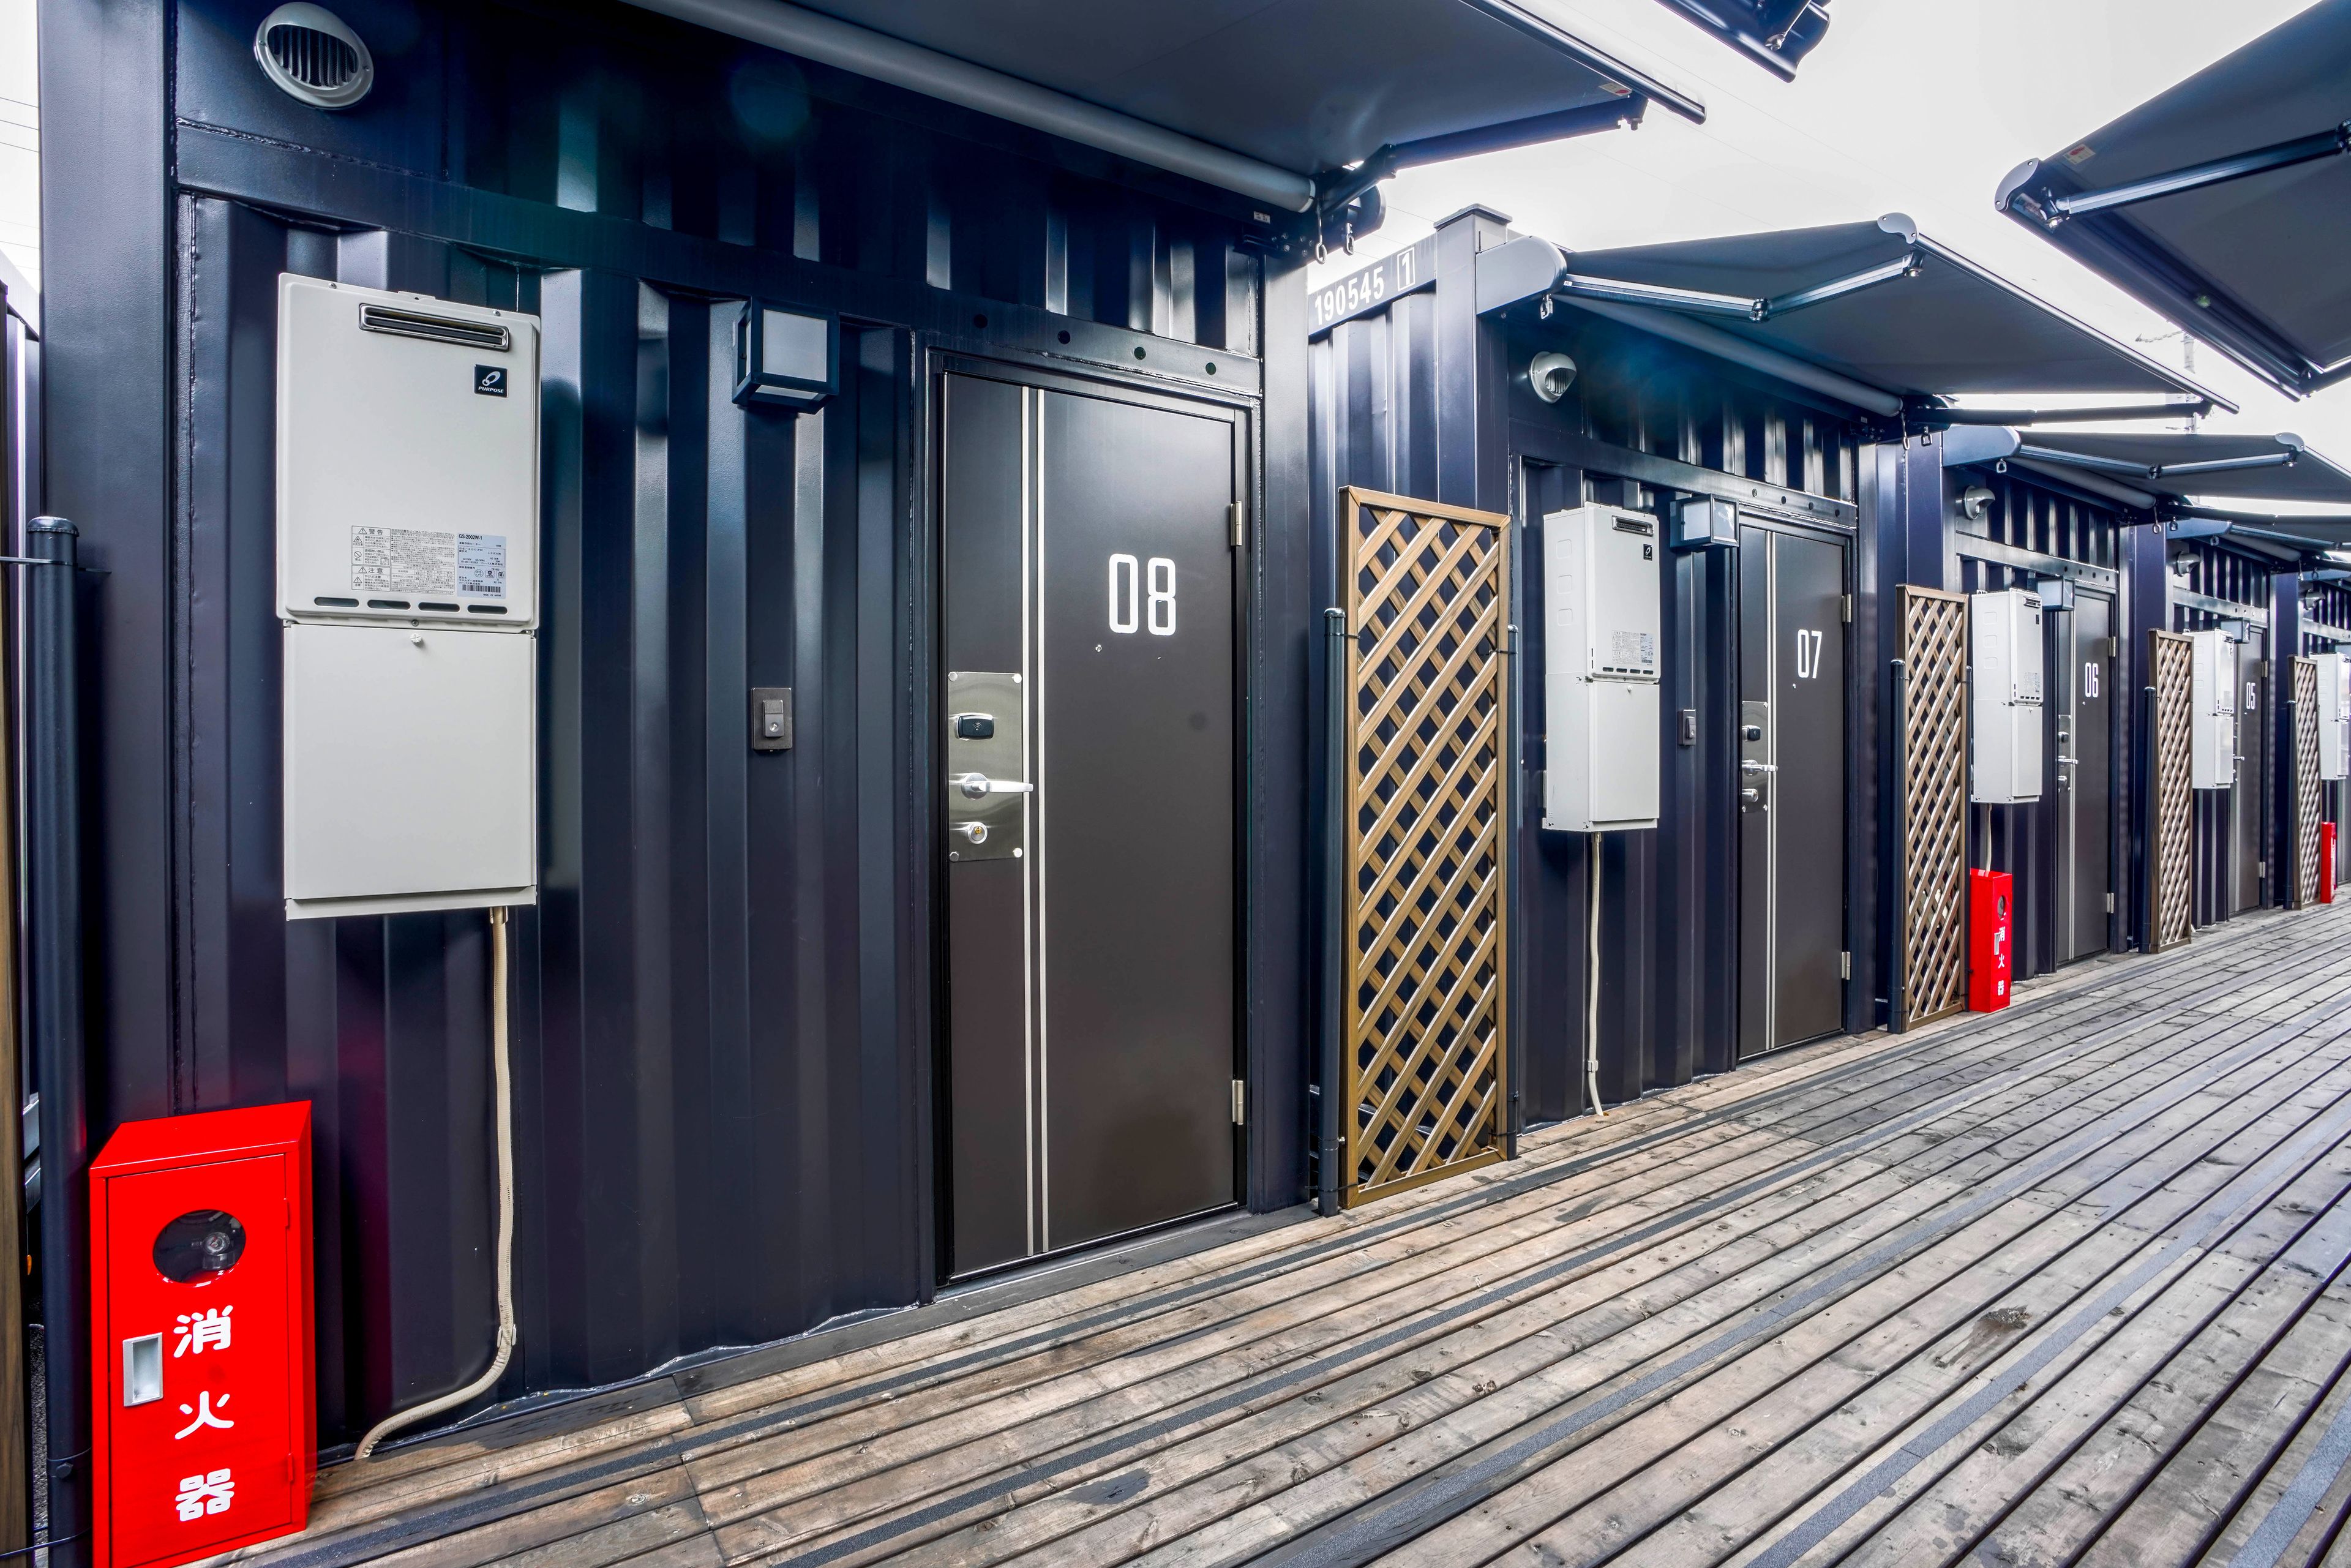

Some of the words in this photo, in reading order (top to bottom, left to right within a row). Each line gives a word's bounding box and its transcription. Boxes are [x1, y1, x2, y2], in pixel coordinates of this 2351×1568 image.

[1314, 266, 1384, 326] 190545
[1402, 252, 1411, 285] 1
[1109, 553, 1176, 636] 08
[1798, 629, 1823, 678] 07
[2085, 662, 2099, 697] 06
[2246, 681, 2256, 710] 05
[173, 1305, 235, 1521] 消火器
